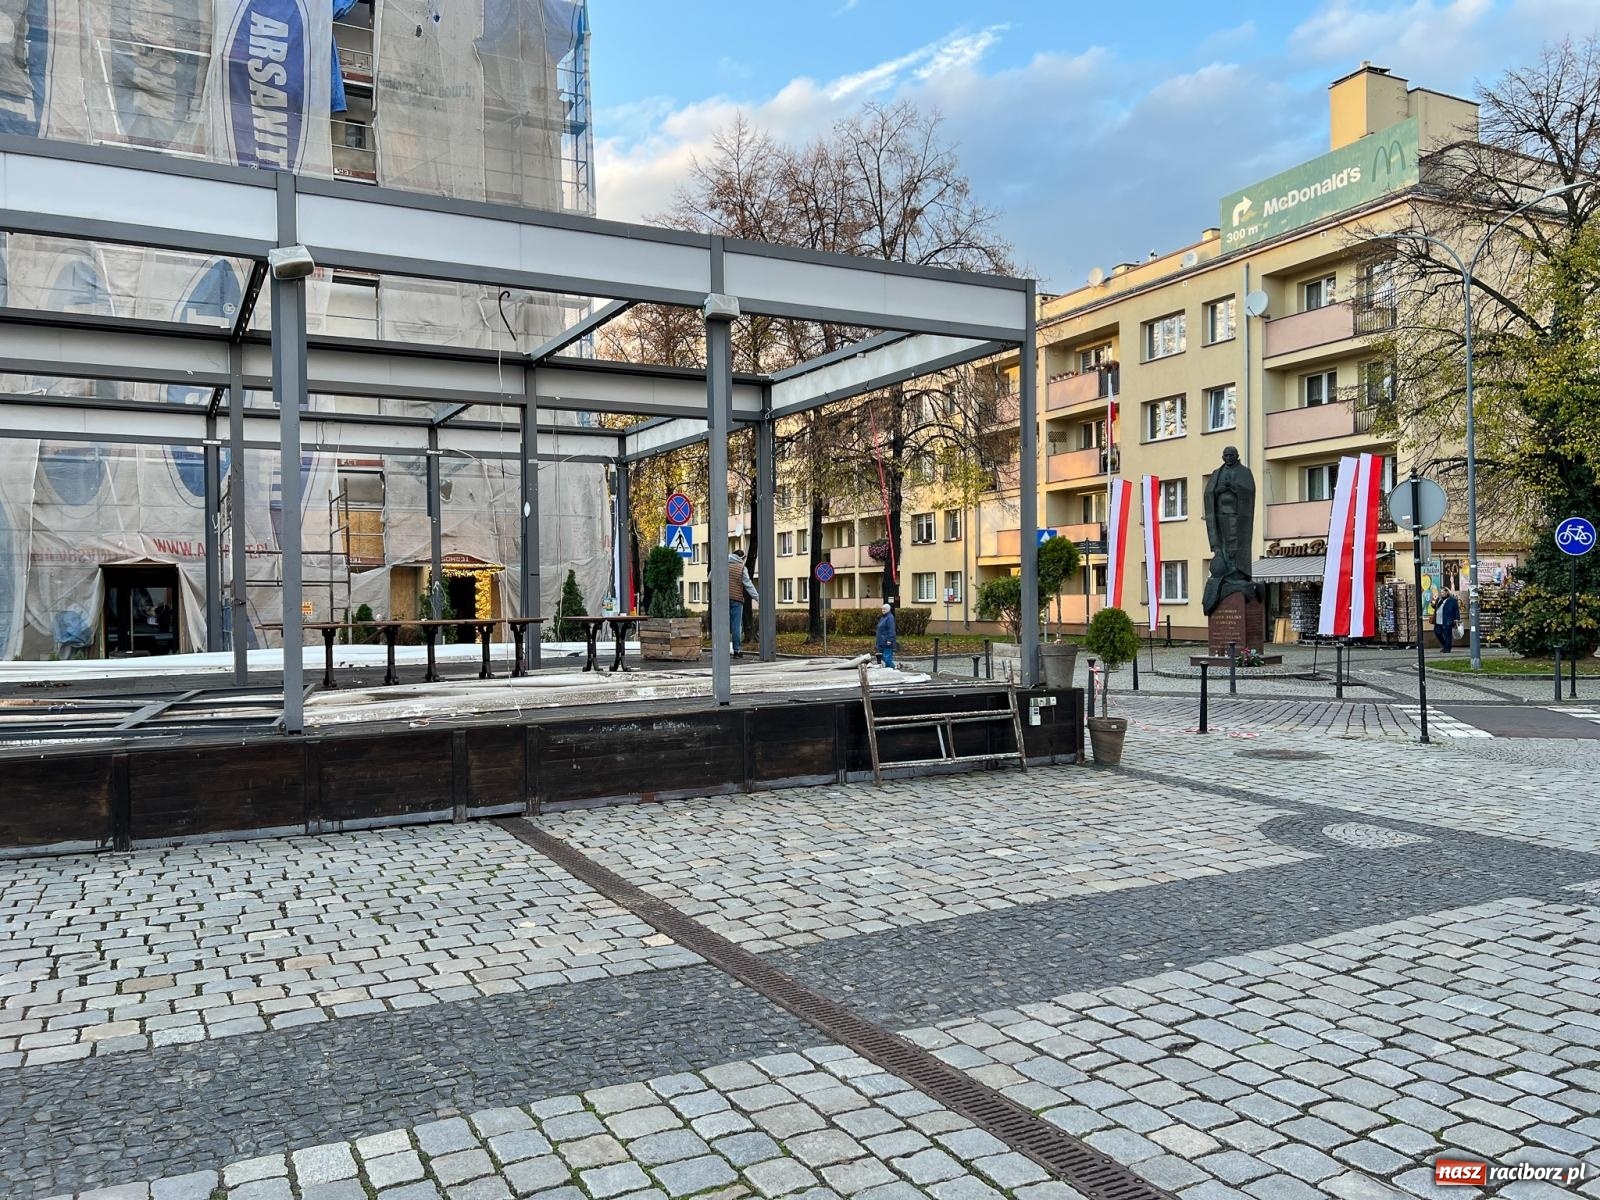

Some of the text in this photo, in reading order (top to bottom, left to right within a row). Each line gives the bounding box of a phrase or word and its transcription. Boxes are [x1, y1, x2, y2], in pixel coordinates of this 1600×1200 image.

[247, 10, 290, 169] ARSANIT
[1263, 165, 1361, 217] McDonald's
[1226, 225, 1259, 243] 300 m
